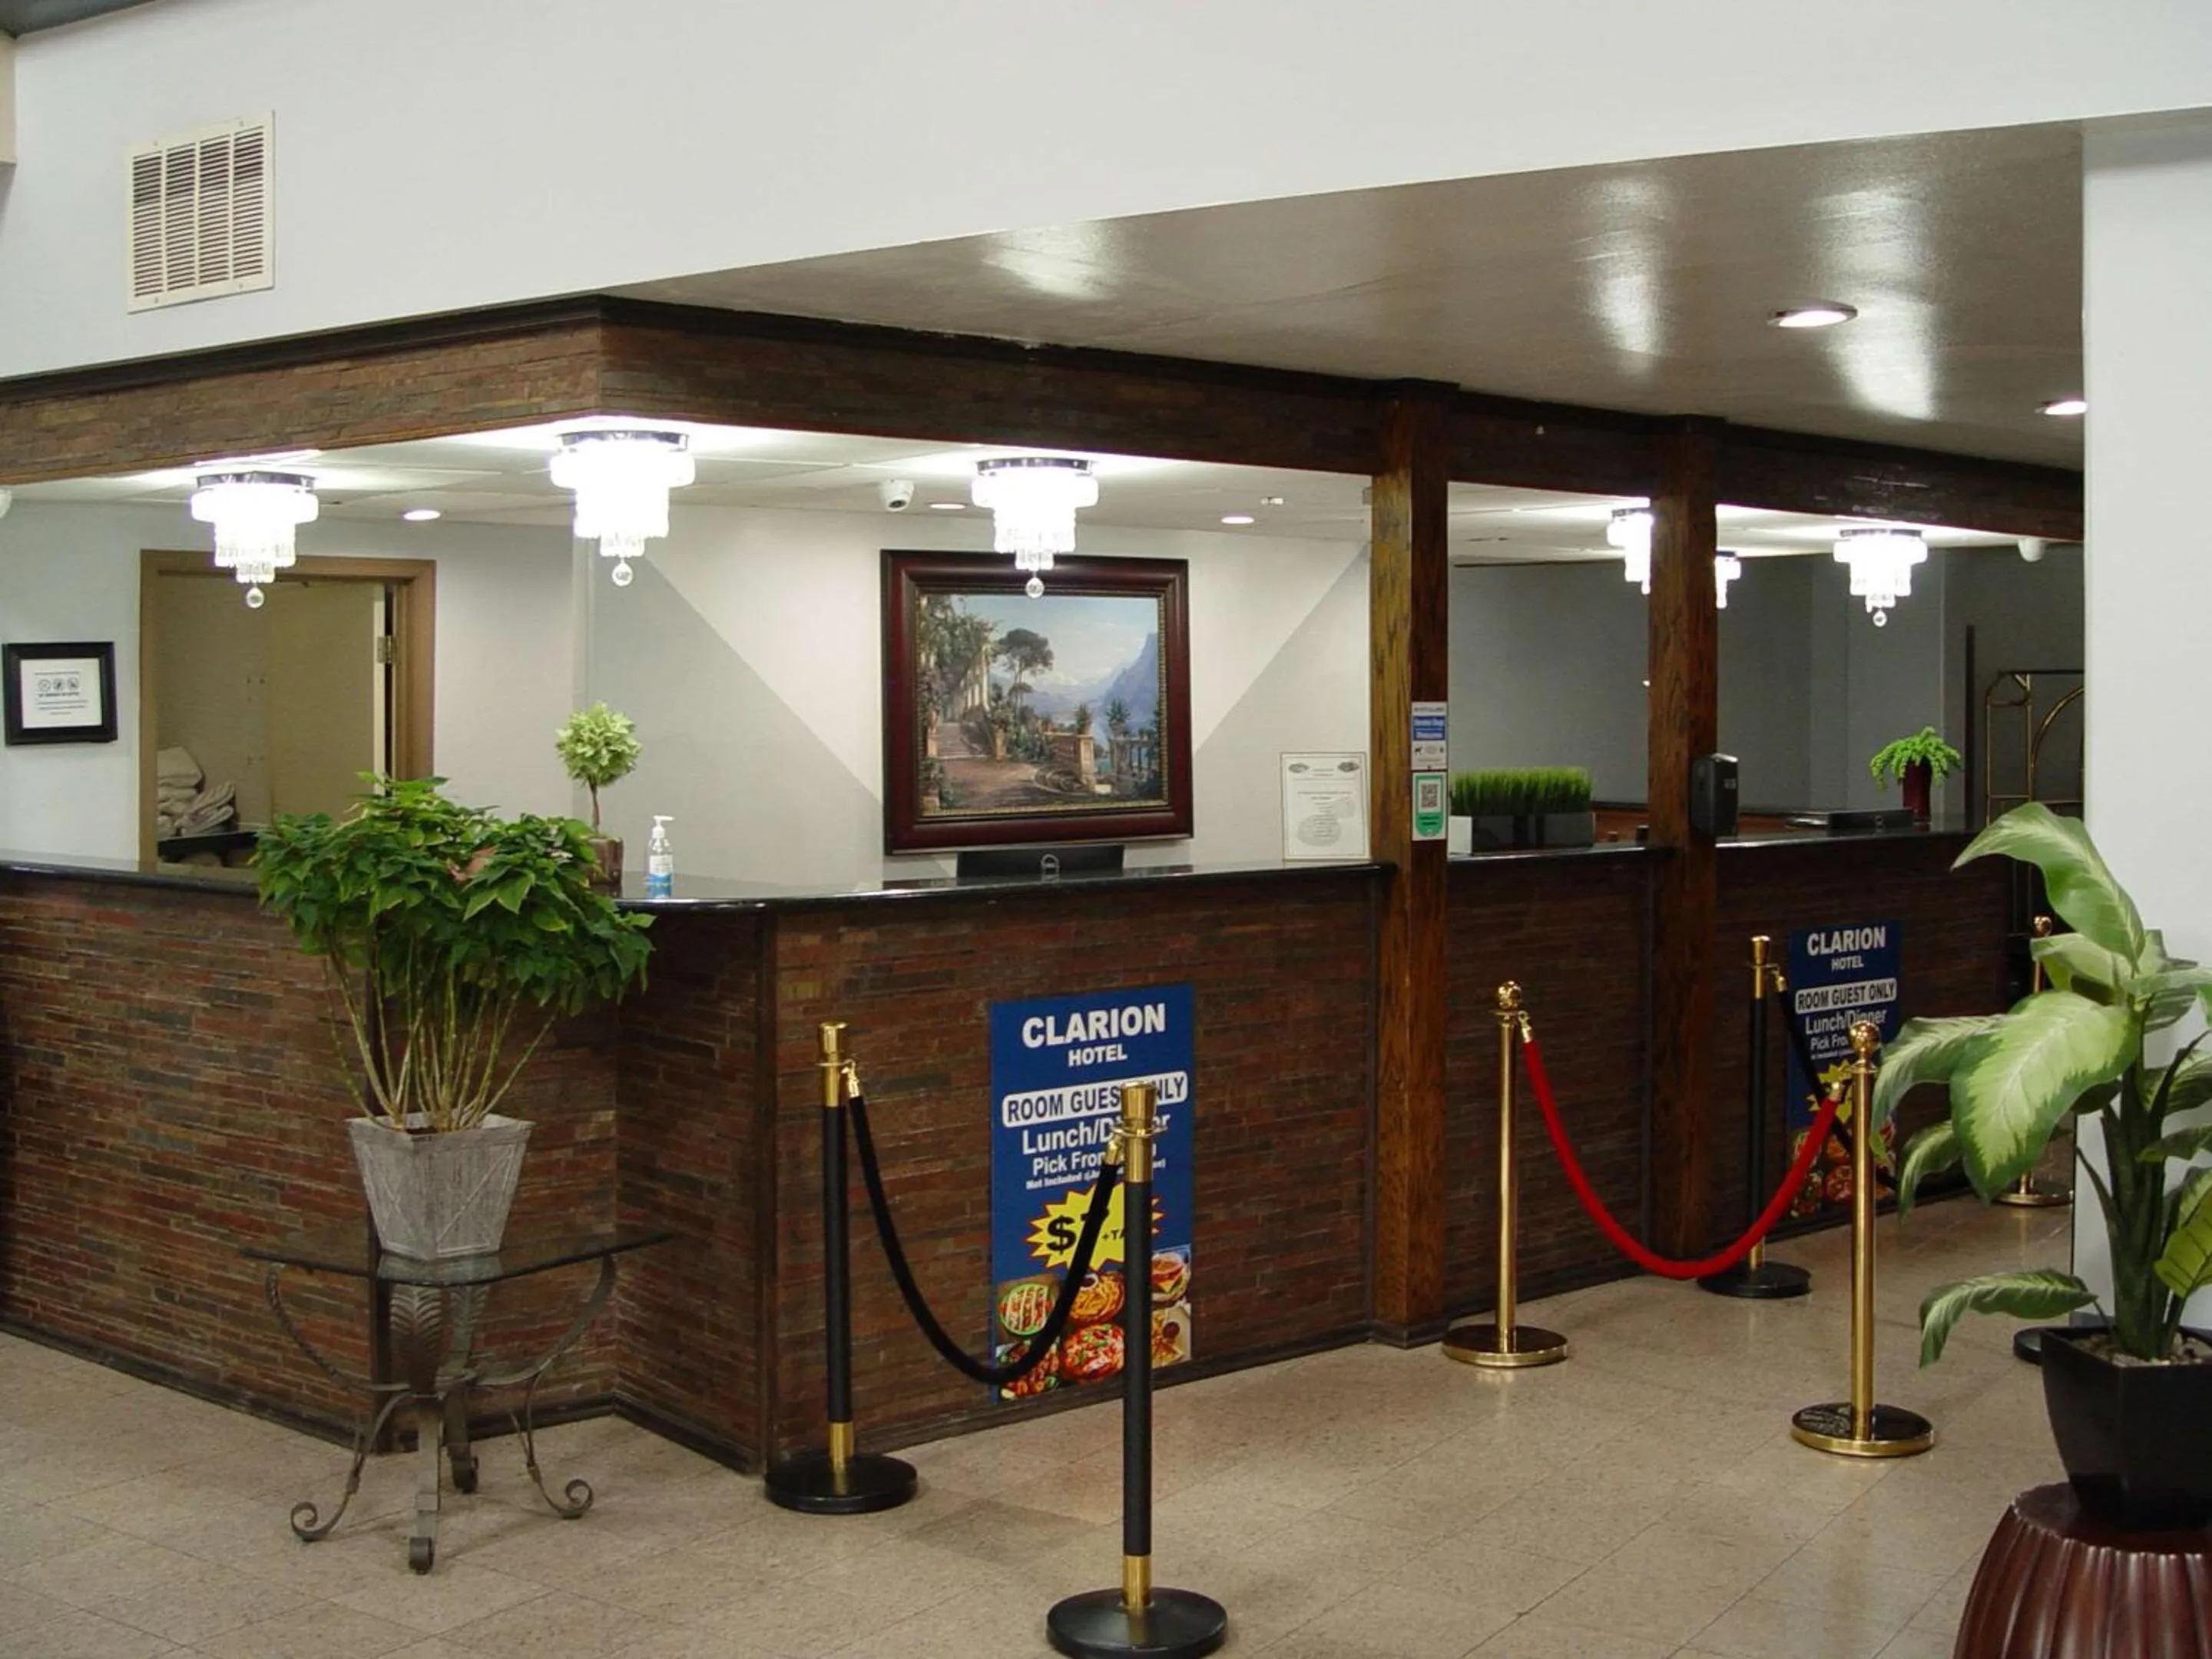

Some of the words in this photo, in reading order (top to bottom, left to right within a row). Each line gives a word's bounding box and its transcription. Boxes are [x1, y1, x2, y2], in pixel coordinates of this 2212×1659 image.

[1807, 926, 1886, 956] CLARION
[1831, 955, 1864, 971] HOTEL
[1797, 990, 1829, 1010] ROOM
[1832, 986, 1865, 1005] GUEST
[1869, 982, 1896, 1000] ONLY
[1022, 1002, 1166, 1048] CLARION
[1068, 1043, 1128, 1068] HOTEL
[1810, 1035, 1830, 1051] Pick
[1832, 1034, 1849, 1048] Fro
[1007, 1093, 1065, 1123] ROOM
[1070, 1084, 1121, 1113] GUES
[1152, 1075, 1184, 1101] NLY
[1022, 1113, 1171, 1155] Lunch/Der
[1032, 1152, 1067, 1176] Pick
